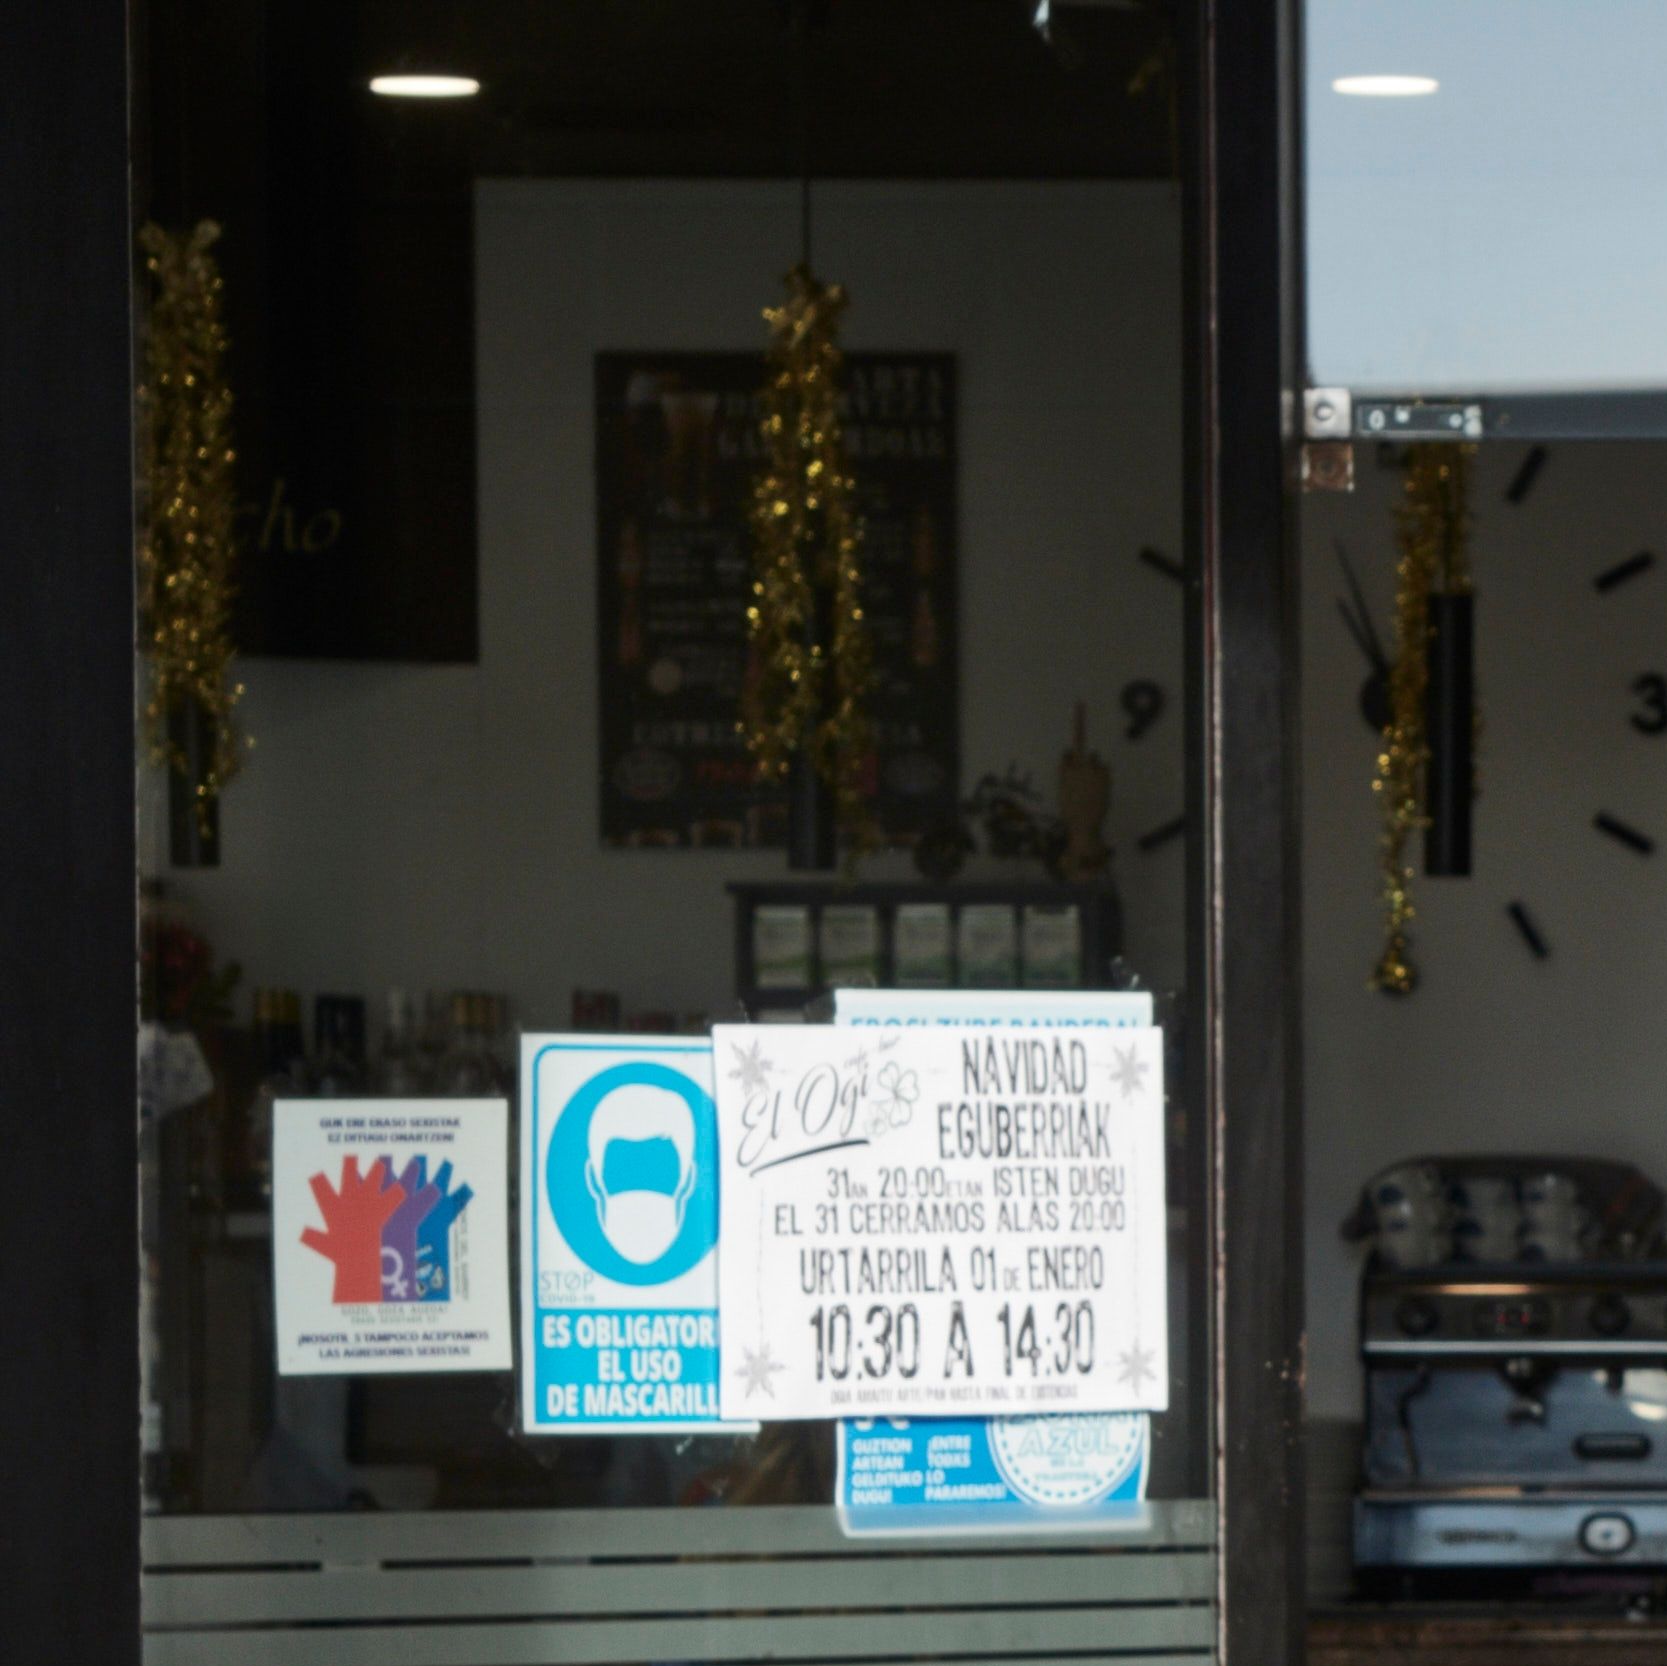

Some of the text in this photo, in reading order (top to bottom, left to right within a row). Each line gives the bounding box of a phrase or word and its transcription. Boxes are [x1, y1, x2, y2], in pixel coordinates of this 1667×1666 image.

[961, 1037, 1087, 1095] NAVIDAD
[737, 1060, 870, 1168] El Ogi
[937, 1100, 1112, 1160] EGUBERRIAK
[992, 1166, 1059, 1198] ISTEN
[1068, 1166, 1125, 1197] DUGU
[774, 1203, 803, 1236] EL
[815, 1203, 840, 1236] 31
[850, 1199, 986, 1234] CERRAMOS
[800, 1245, 1103, 1294] URTARRILA 01 DE ENERO
[542, 1314, 716, 1349] ES OBLIGATOR
[944, 1299, 974, 1379] A
[996, 1300, 1095, 1377] 14:30
[597, 1349, 682, 1382] EL USO
[547, 1384, 579, 1418] DE
[925, 1469, 945, 1485] LO
